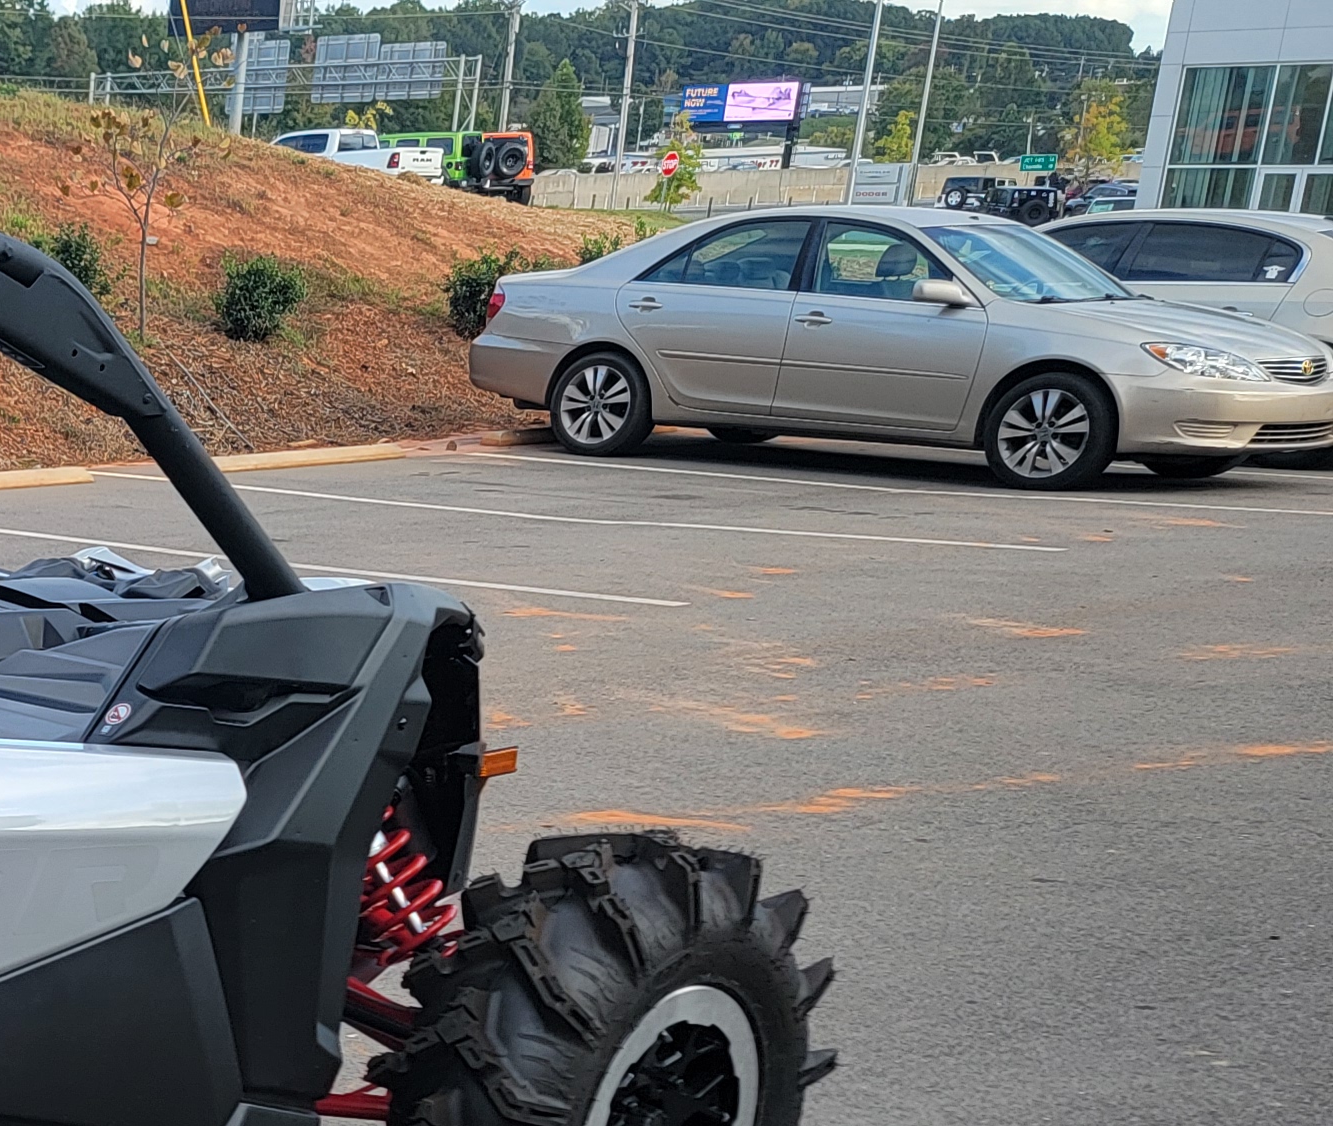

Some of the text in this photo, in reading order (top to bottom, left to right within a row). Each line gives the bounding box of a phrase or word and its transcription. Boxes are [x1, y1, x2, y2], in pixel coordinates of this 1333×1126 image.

[685, 87, 719, 98] FUTURE
[684, 98, 705, 108] NOW
[662, 159, 678, 170] STOP
